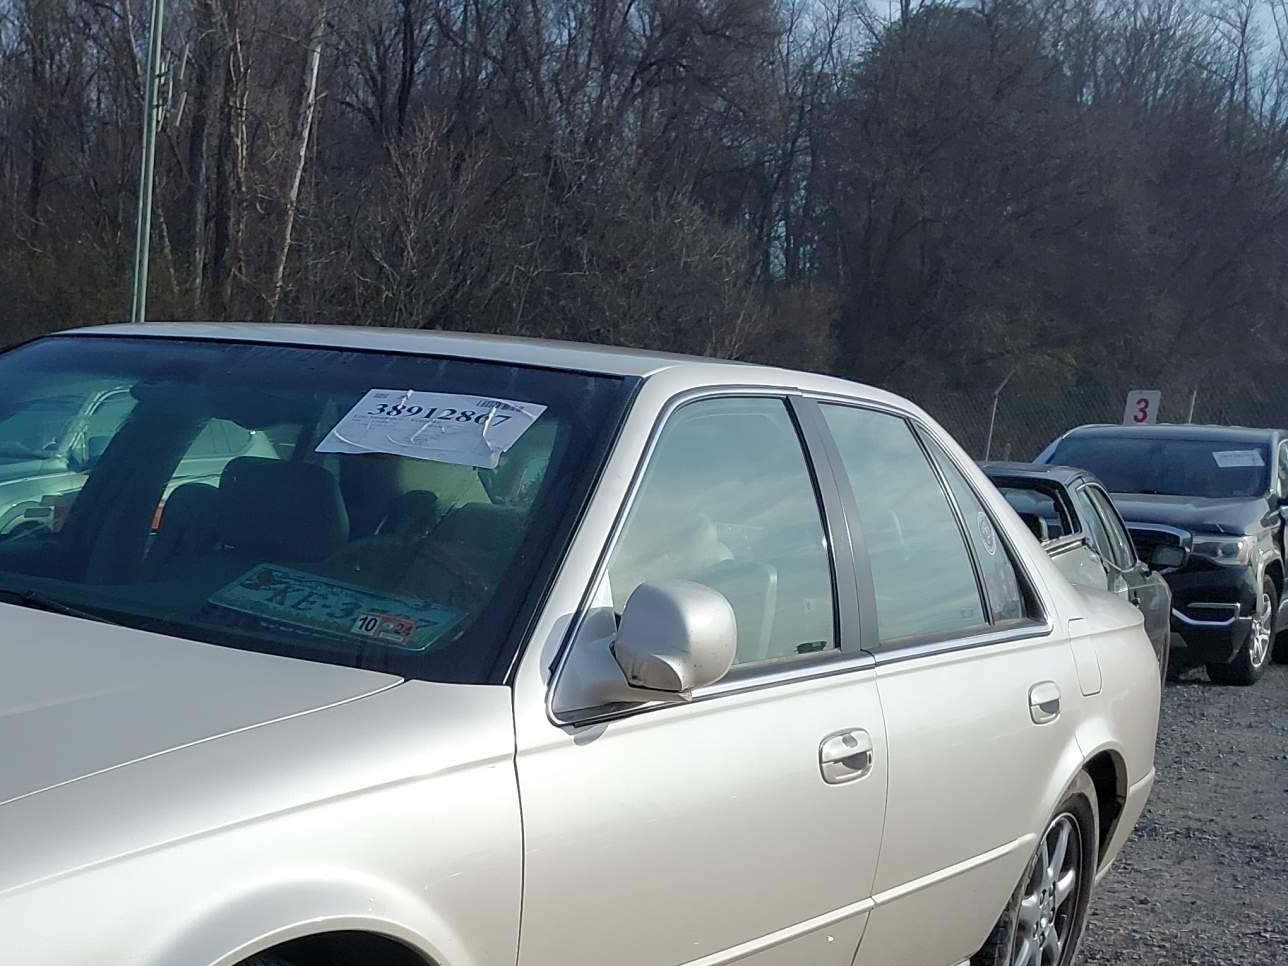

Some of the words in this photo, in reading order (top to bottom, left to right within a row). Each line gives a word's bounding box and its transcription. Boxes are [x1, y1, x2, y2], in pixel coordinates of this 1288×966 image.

[367, 403, 511, 428] 38912867
[1132, 398, 1149, 423] 3
[359, 616, 378, 632] 10
[395, 622, 413, 636] 24
